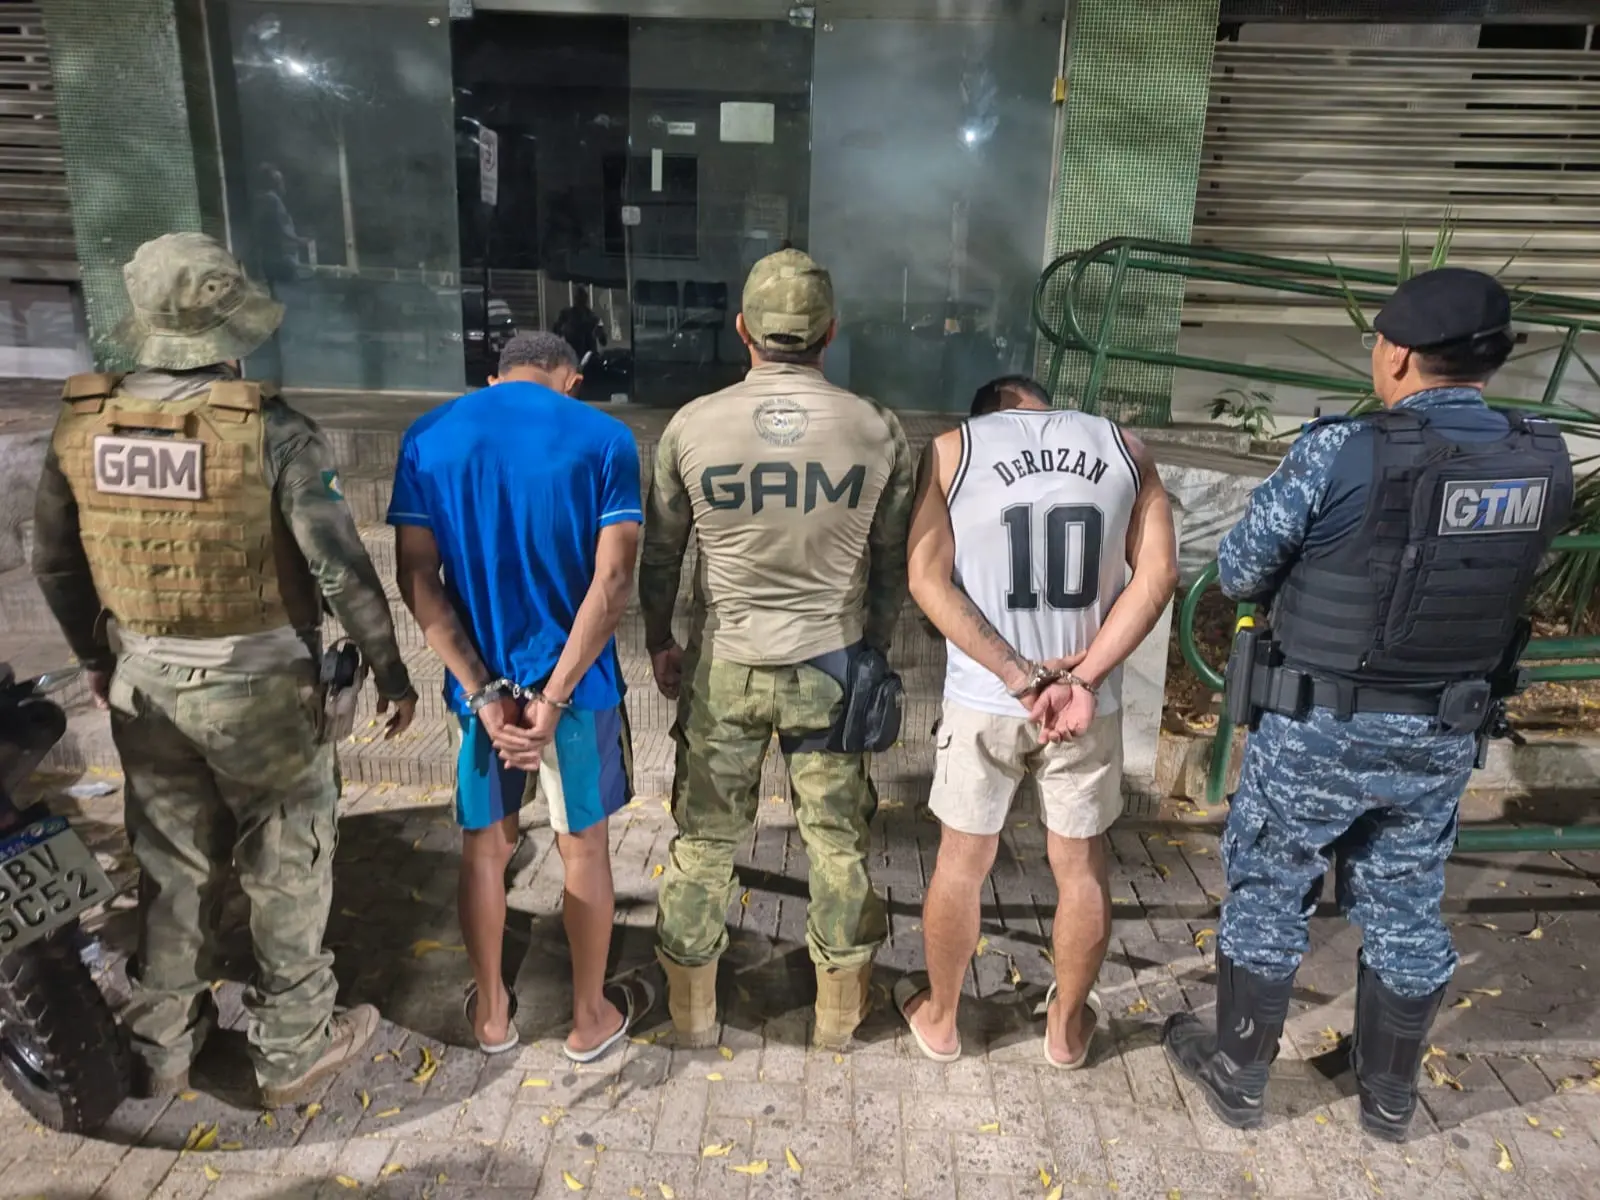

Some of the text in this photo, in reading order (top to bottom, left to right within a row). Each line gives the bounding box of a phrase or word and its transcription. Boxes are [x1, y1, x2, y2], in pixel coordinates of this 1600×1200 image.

[100, 444, 196, 491] GAM
[701, 461, 866, 515] GAM
[1446, 486, 1542, 527] GTM
[1000, 502, 1105, 612] 10
